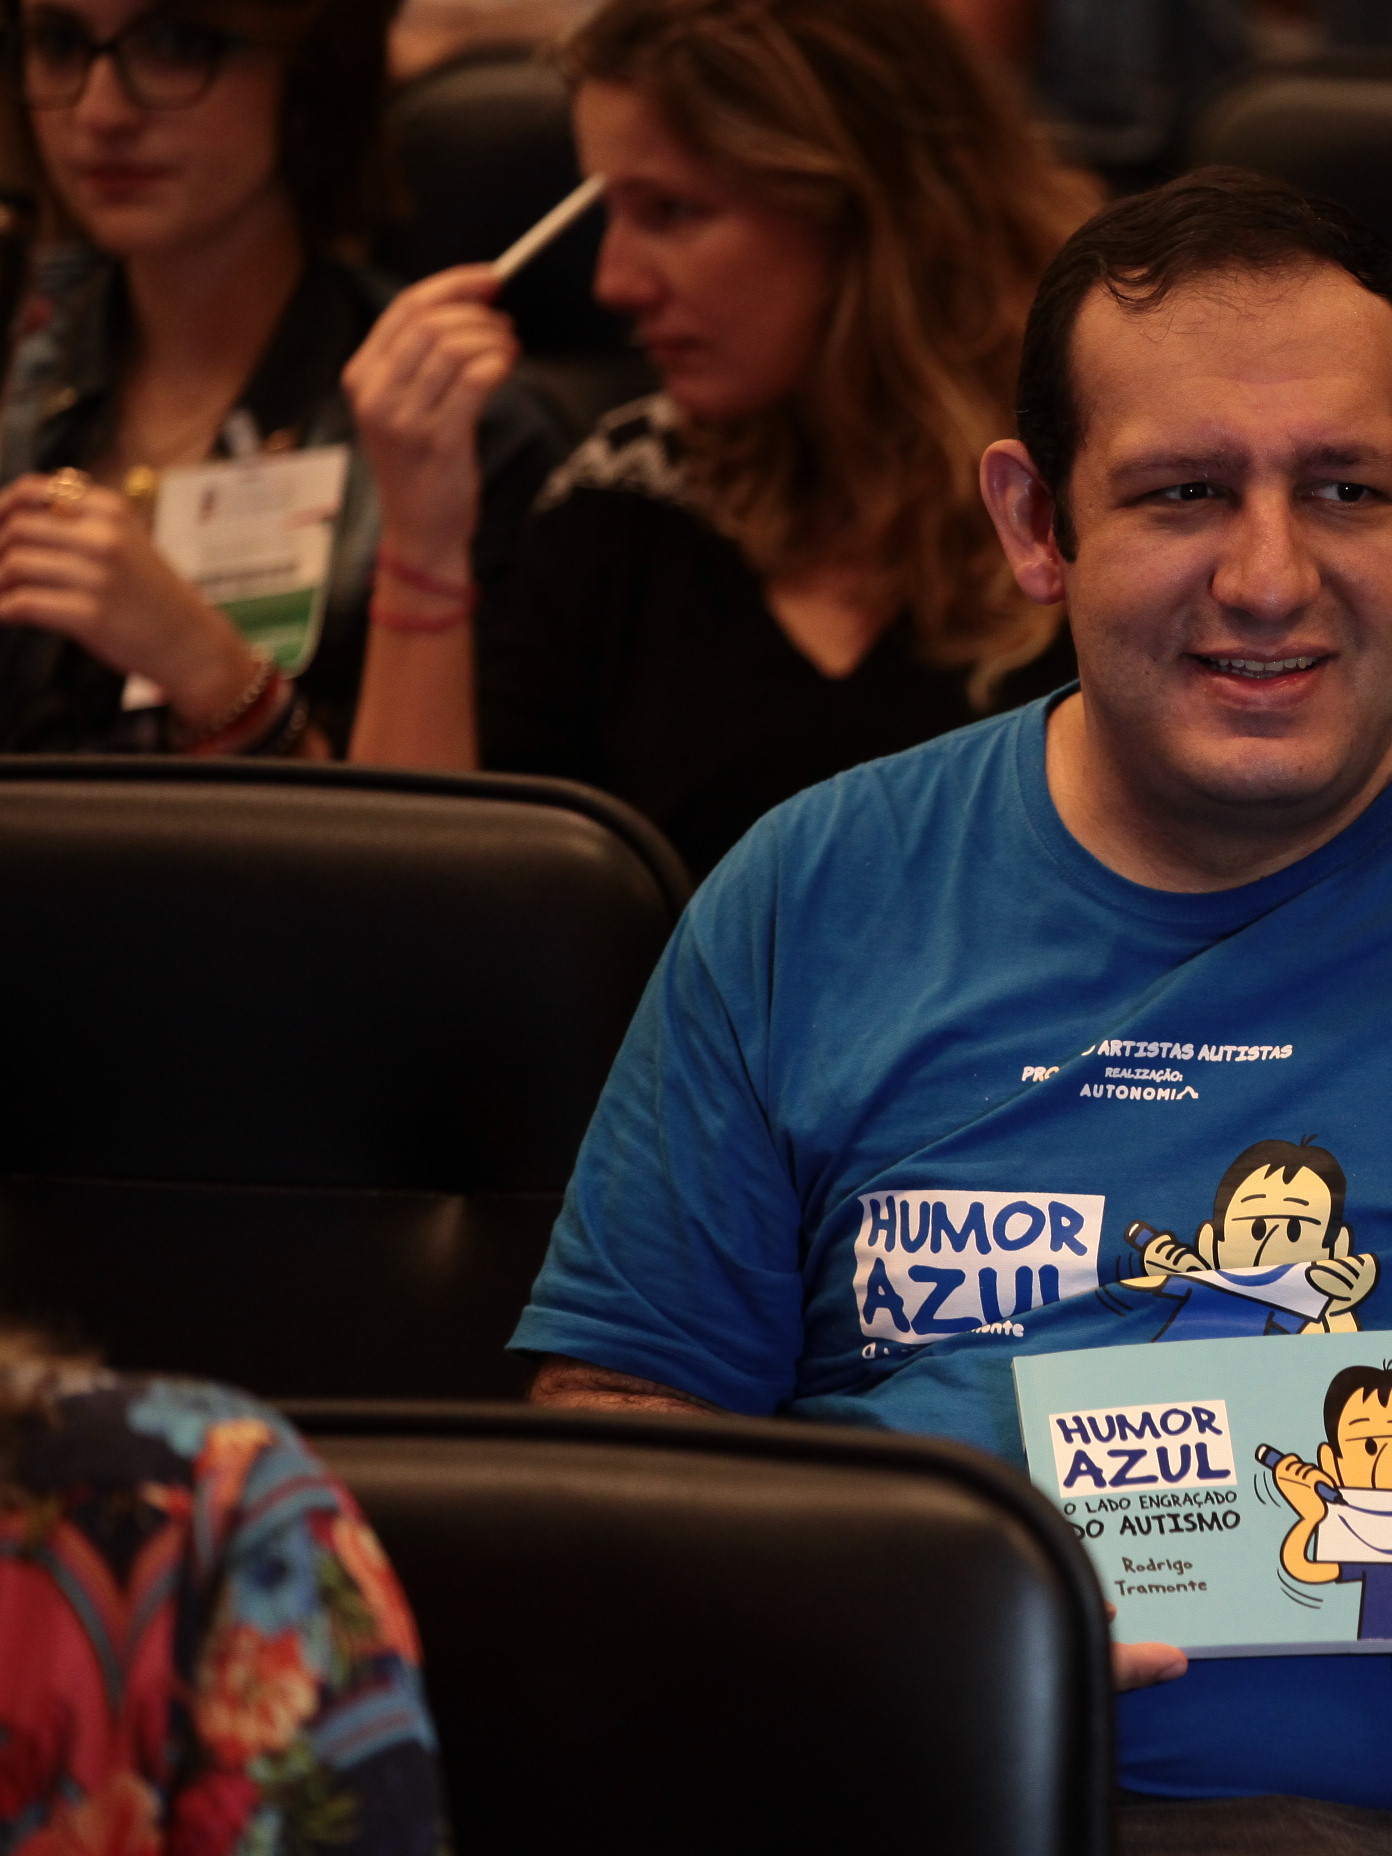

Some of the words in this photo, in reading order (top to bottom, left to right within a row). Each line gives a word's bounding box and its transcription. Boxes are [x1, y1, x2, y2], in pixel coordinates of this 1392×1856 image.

[1097, 1039, 1194, 1060] ARTISTAS
[1197, 1044, 1293, 1062] AUTISTAS
[867, 1195, 1088, 1257] HUMOR
[1056, 1406, 1223, 1445] HUMOR
[1063, 1441, 1231, 1489] AZUL
[1064, 1502, 1077, 1515] O
[1085, 1497, 1131, 1513] LADO
[1139, 1490, 1238, 1508] ENGRAÇADO
[1119, 1509, 1241, 1537] AUTISMO
[1121, 1556, 1194, 1576] Rodrigo
[1113, 1578, 1208, 1597] Tramonte
